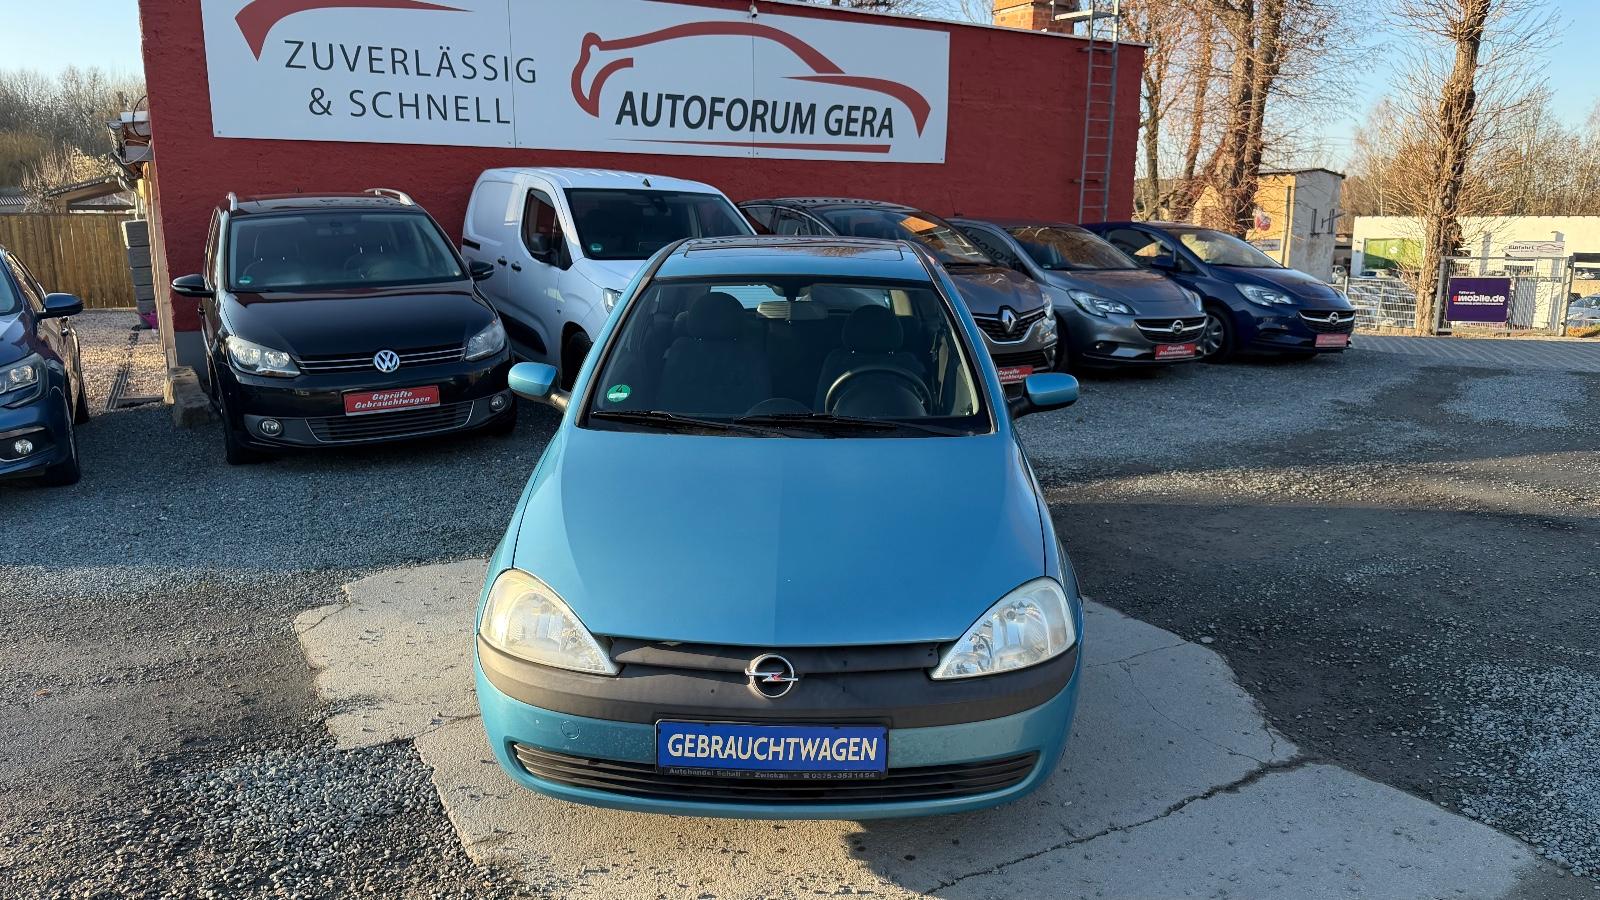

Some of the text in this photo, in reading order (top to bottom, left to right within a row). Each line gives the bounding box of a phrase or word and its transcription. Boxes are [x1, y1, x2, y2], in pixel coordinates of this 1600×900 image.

[284, 39, 537, 84] ZUVERLÄSSIG
[308, 87, 511, 125] & SCHNELL
[615, 90, 895, 139] AUTOFORUM GERA
[355, 396, 430, 408] Gebrauchtwagen
[372, 390, 413, 401] Geprüfte
[667, 733, 878, 762] GEBRAUCHTWAGEN
